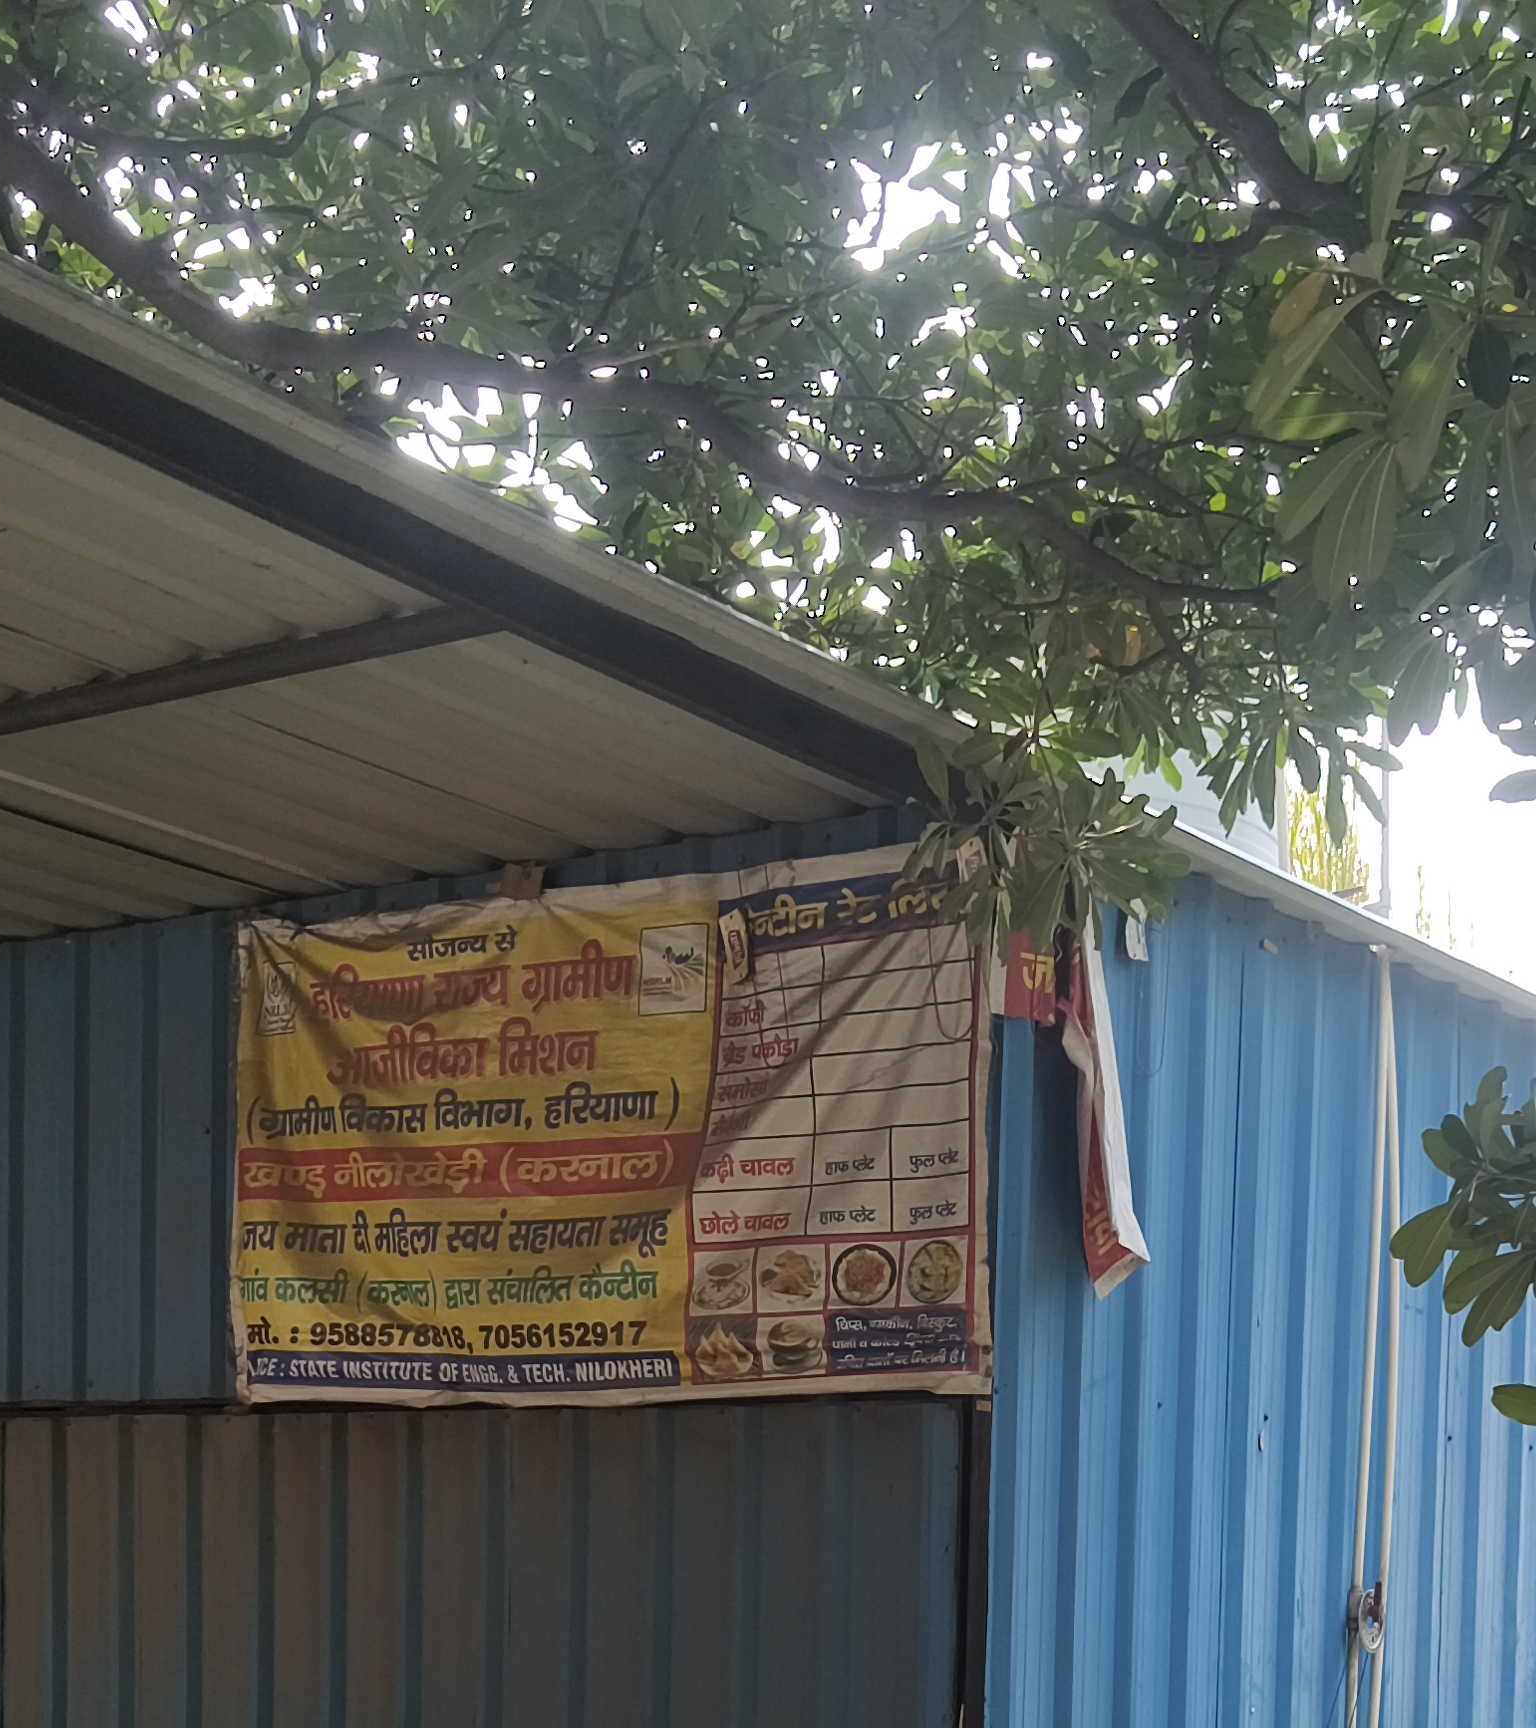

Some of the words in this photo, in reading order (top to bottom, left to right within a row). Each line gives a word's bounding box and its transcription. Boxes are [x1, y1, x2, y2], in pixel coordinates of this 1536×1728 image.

[407, 934, 489, 961] सौजन्य
[495, 924, 518, 951] से
[434, 964, 512, 1010] राज्य
[521, 939, 638, 1013] ग्रामीण
[327, 1021, 490, 1086] आजीविका
[498, 1016, 600, 1077] मिशन
[339, 1093, 428, 1133] विकास
[434, 1088, 533, 1130] विभाग,
[499, 1138, 674, 1195] (करनाल)
[739, 1156, 796, 1176] चावल
[909, 1153, 936, 1173] फुल
[242, 1220, 279, 1251] जय
[284, 1220, 347, 1254] माता
[352, 1209, 371, 1254] दी
[374, 1207, 442, 1257] महिला
[446, 1207, 508, 1253] स्वयं
[508, 1216, 607, 1254] सहायता
[609, 1208, 672, 1258] समूह
[699, 1209, 740, 1234] छोले
[744, 1212, 792, 1231] चावल
[443, 1278, 482, 1310] द्वारा
[486, 1264, 574, 1305] संचालित
[579, 1258, 659, 1301] कैन्टीन
[479, 1320, 648, 1350] 7056152917
[289, 1359, 340, 1378] STATE
[343, 1360, 433, 1381] INSTITUTE
[439, 1362, 459, 1382] OF
[462, 1363, 503, 1384] ENGG.
[507, 1364, 519, 1384] &
[522, 1362, 571, 1384] TECH.
[575, 1357, 673, 1384] NILOKHERI
